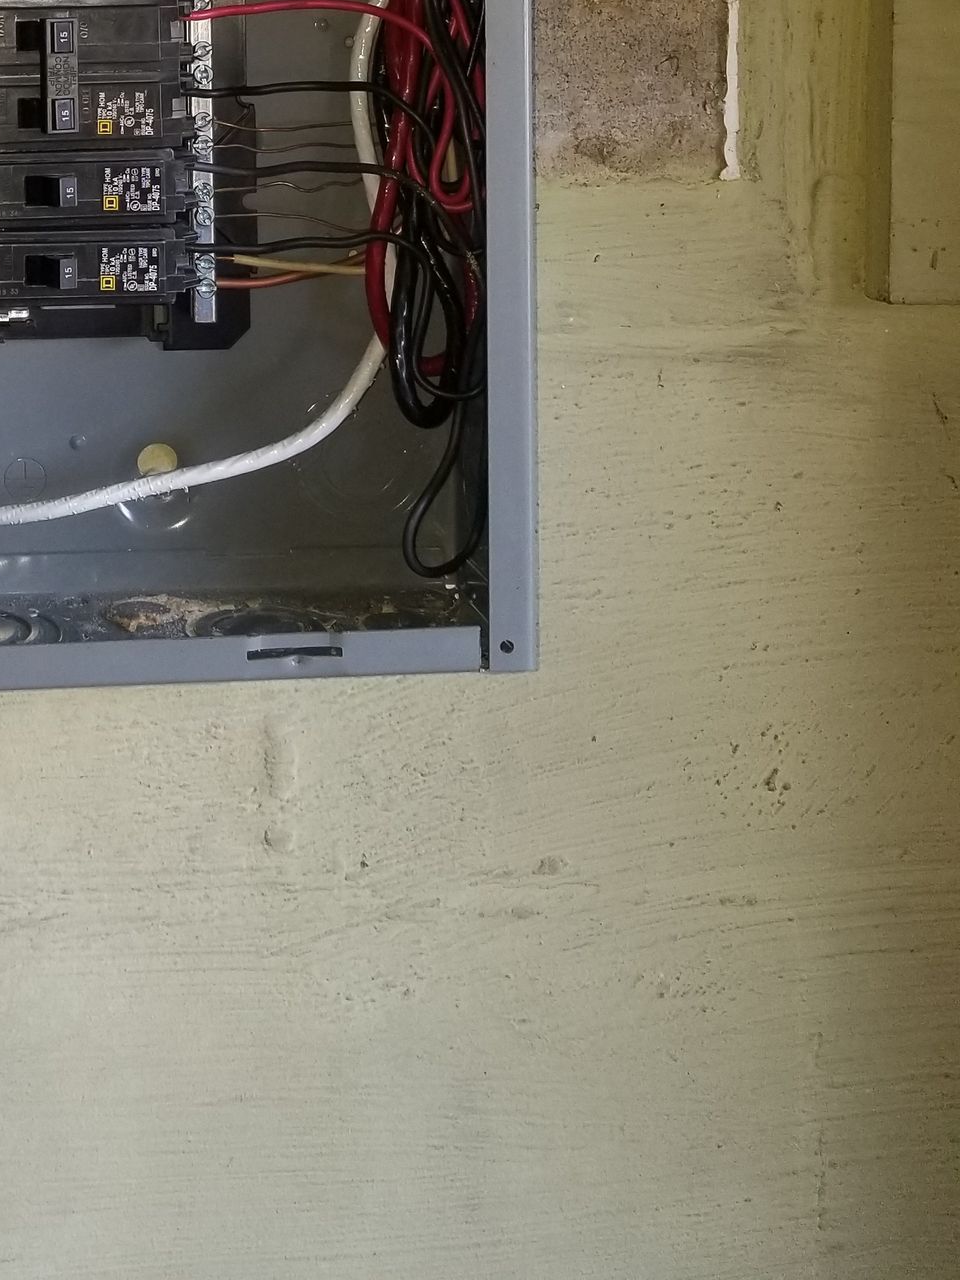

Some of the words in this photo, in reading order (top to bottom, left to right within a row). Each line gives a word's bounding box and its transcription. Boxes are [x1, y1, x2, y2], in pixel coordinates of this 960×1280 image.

[59, 31, 69, 43] 15
[61, 109, 70, 121] 15
[145, 108, 154, 136] DP-4075
[66, 187, 74, 199] 15
[151, 184, 160, 211] DP-4075
[64, 267, 73, 279] 15
[148, 264, 157, 291] DP-4075
